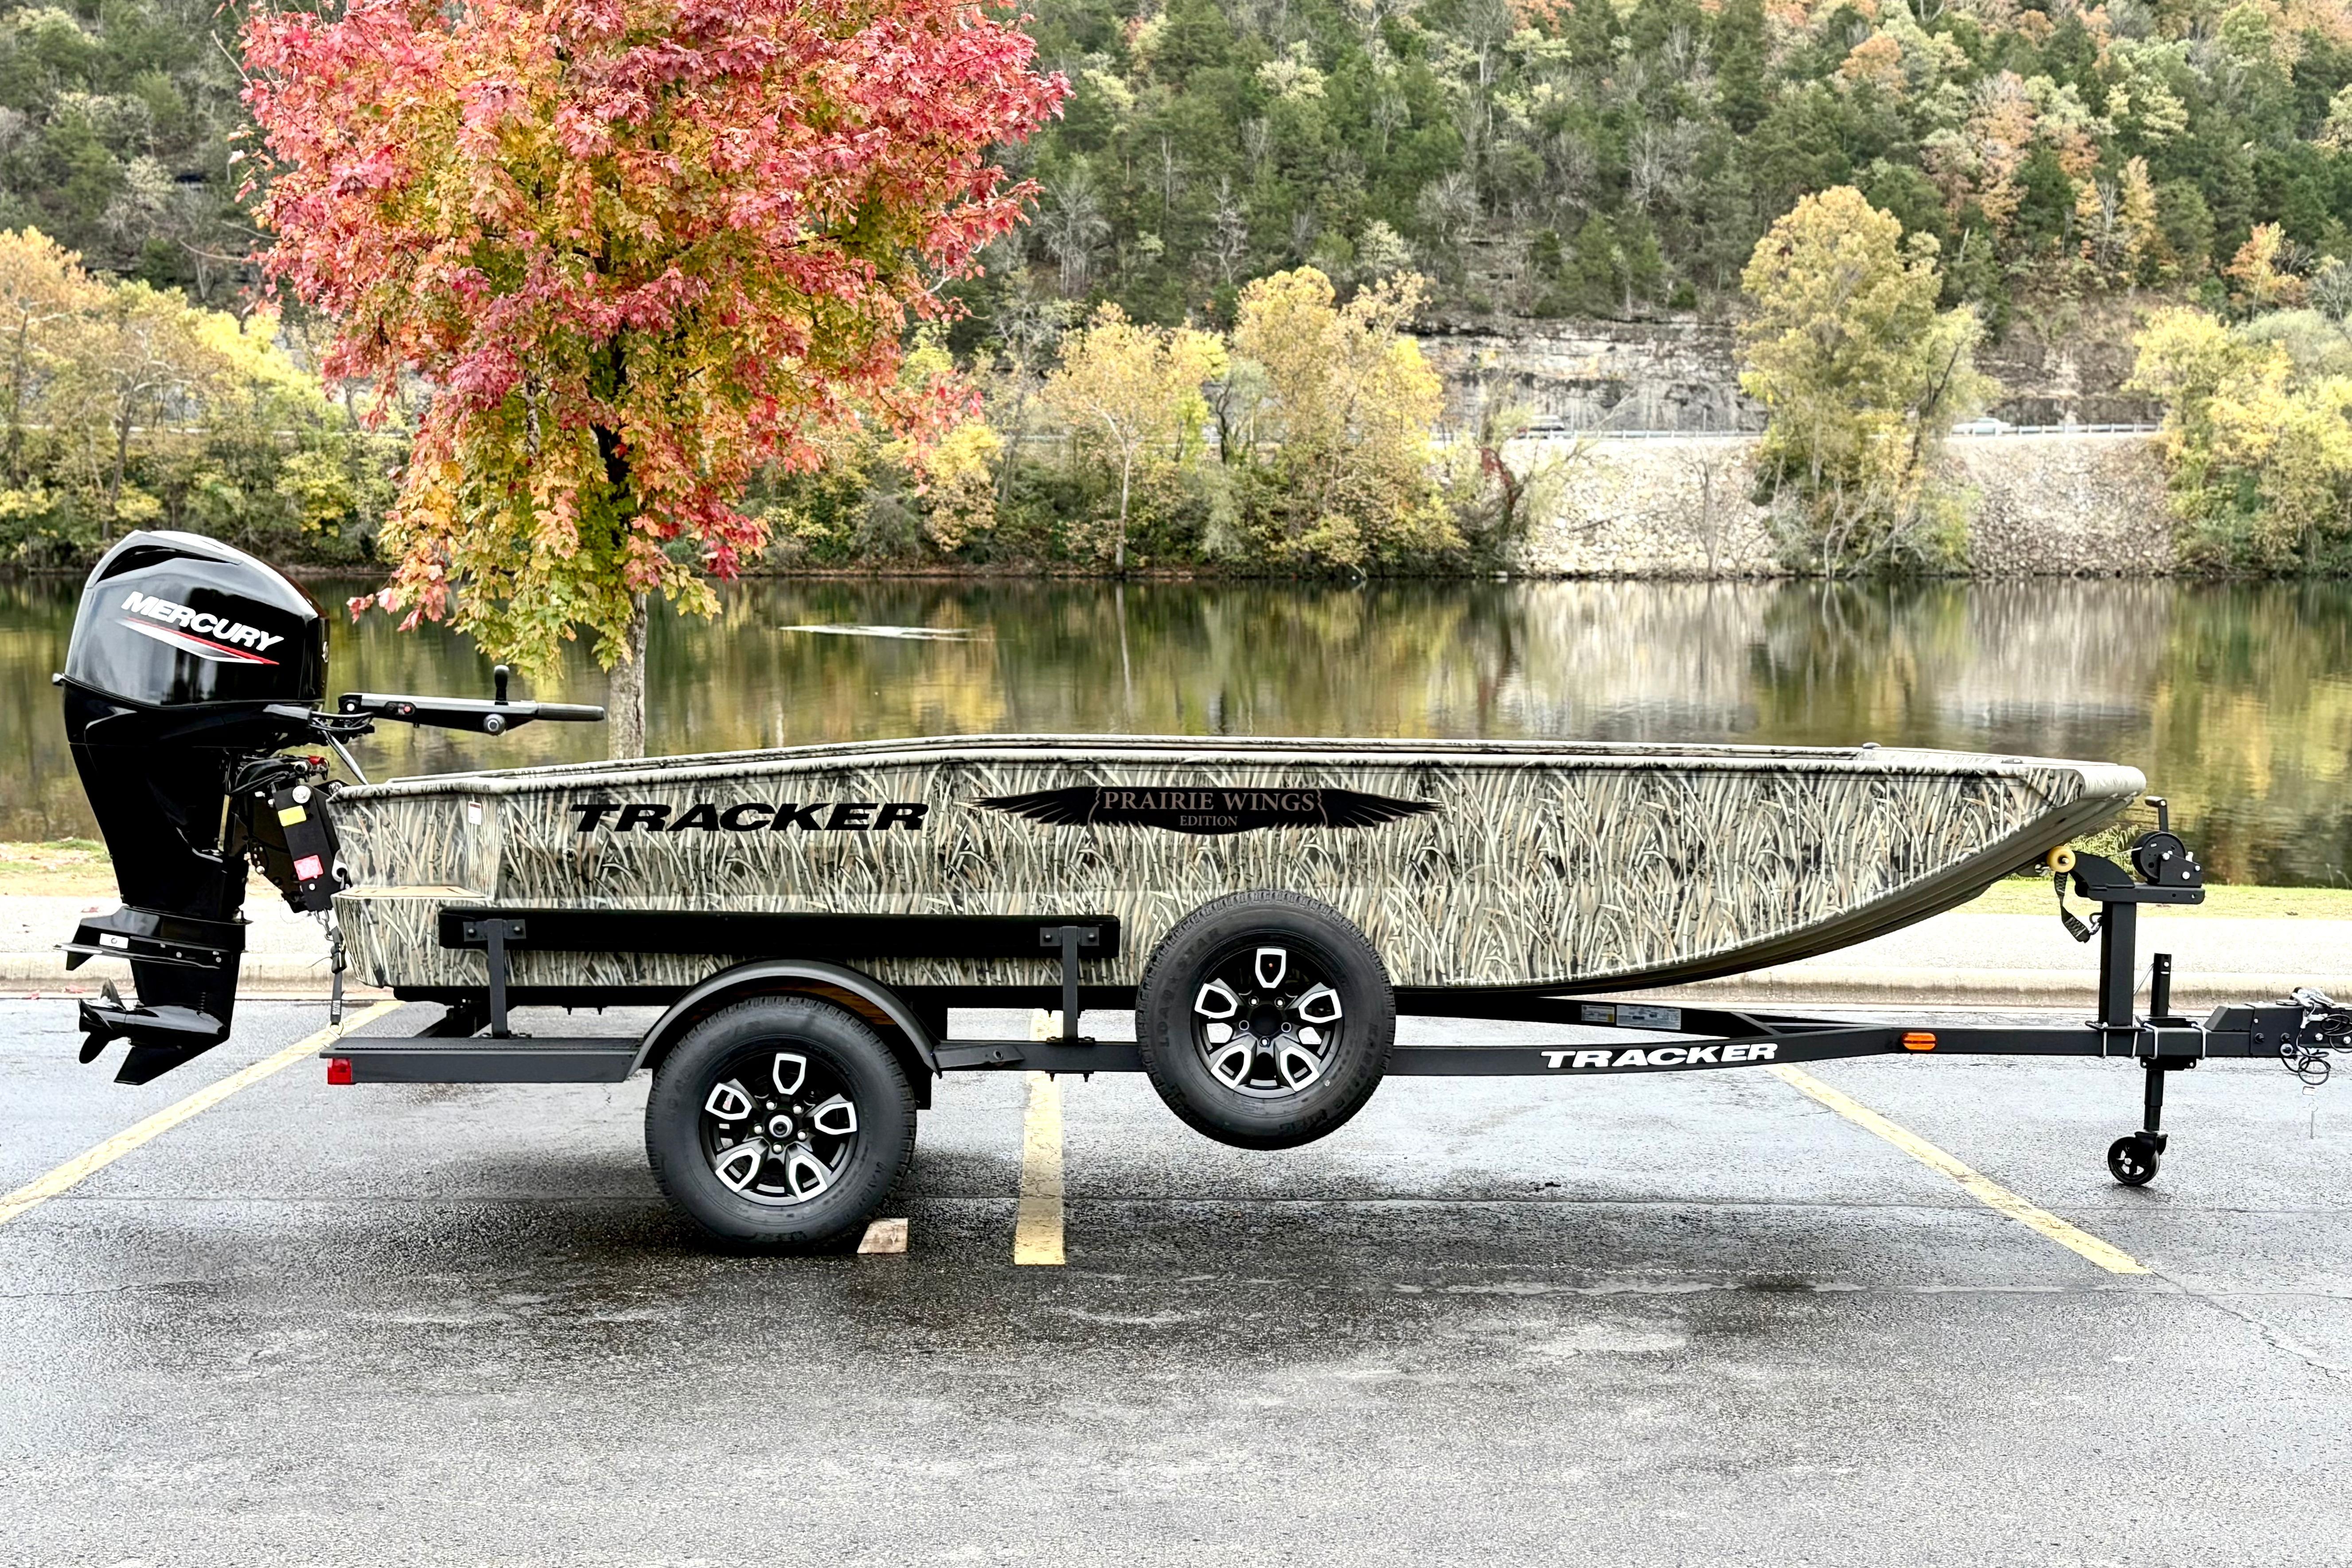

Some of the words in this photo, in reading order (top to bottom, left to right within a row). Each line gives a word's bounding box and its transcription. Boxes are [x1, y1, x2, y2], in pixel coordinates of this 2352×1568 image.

[121, 591, 284, 651] MERCURY
[1103, 792, 1213, 810] PRAIRIE
[1221, 793, 1314, 811] WINGS
[570, 803, 929, 832] TRACKER
[1180, 815, 1238, 827] EDITION
[1541, 1043, 1778, 1069] TRACKER
